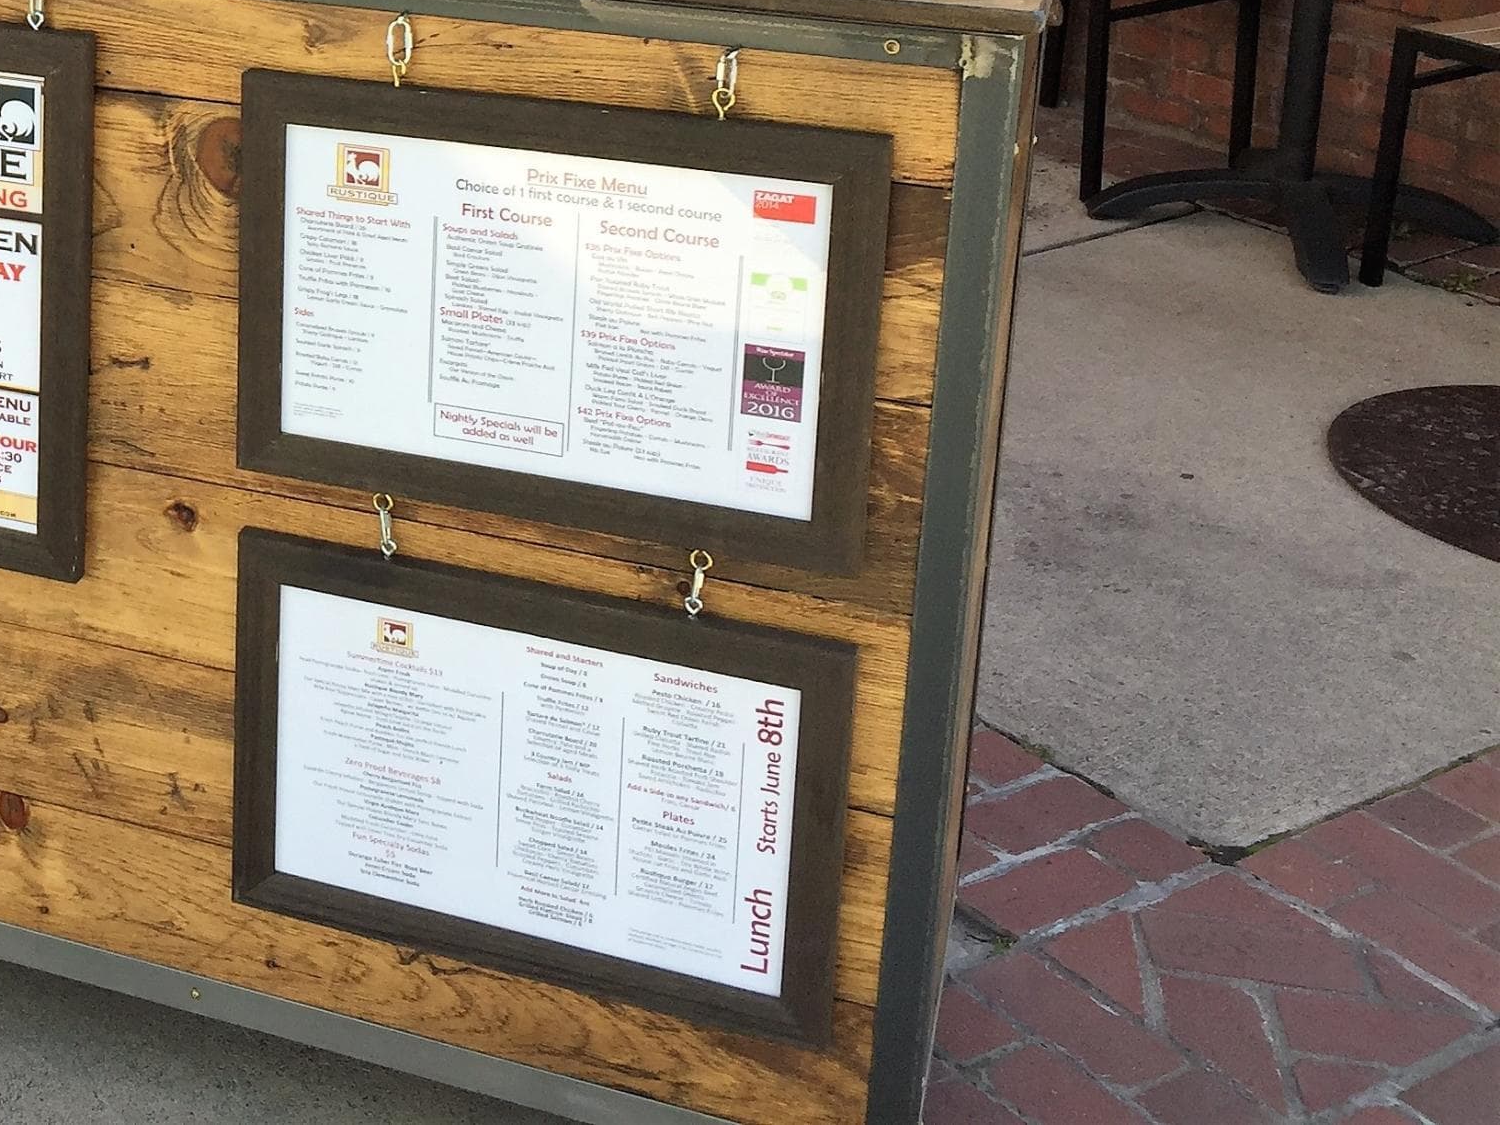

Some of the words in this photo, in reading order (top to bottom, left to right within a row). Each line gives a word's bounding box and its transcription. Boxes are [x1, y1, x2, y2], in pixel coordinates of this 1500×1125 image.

[527, 168, 558, 185] Prix
[563, 173, 596, 189] Fixe
[601, 177, 648, 196] Menu
[331, 188, 394, 202] RUSTIQUE
[455, 178, 499, 194] Choice
[503, 186, 516, 196] of
[528, 187, 552, 201] first
[556, 194, 599, 207] course
[603, 197, 613, 208] &
[627, 201, 673, 215] second
[678, 208, 722, 222] course
[755, 192, 795, 204] ZAGAT
[296, 207, 325, 217] Shared
[328, 211, 353, 222] Things
[367, 216, 388, 225] Start
[390, 219, 411, 228] With
[462, 203, 494, 220] First
[500, 207, 553, 226] Course
[443, 223, 467, 234] Soups
[490, 230, 518, 240] Salads
[600, 221, 658, 240] Second
[663, 228, 720, 248] Course
[295, 307, 314, 316] Sides
[440, 307, 468, 319] Small
[471, 311, 503, 324] Plates
[599, 332, 617, 342] Prix
[640, 338, 676, 350] Options
[754, 383, 791, 393] AWARD
[596, 409, 612, 419] Prix
[636, 415, 671, 428] Options
[748, 402, 795, 419] 2016
[440, 410, 478, 425] Nightly
[481, 417, 520, 431] Specials
[524, 426, 541, 434] will
[544, 427, 558, 437] be
[462, 426, 496, 439] added
[500, 433, 509, 441] as
[513, 435, 534, 445] well
[747, 453, 789, 466] AWARDS
[526, 646, 554, 657] Shared
[572, 656, 603, 667] Starters
[654, 673, 718, 694] Sandwiches
[755, 697, 785, 747] 8th
[345, 758, 363, 768] Zero
[365, 761, 386, 773] Proof
[388, 767, 429, 783] Beverages
[547, 772, 572, 783] Salads
[760, 751, 783, 798] June
[663, 811, 695, 825] Plates
[756, 800, 779, 855] Starts
[353, 832, 368, 841] Fun
[370, 836, 404, 851] Specialty
[407, 844, 430, 856] Sodas
[740, 887, 773, 975] Lunch
